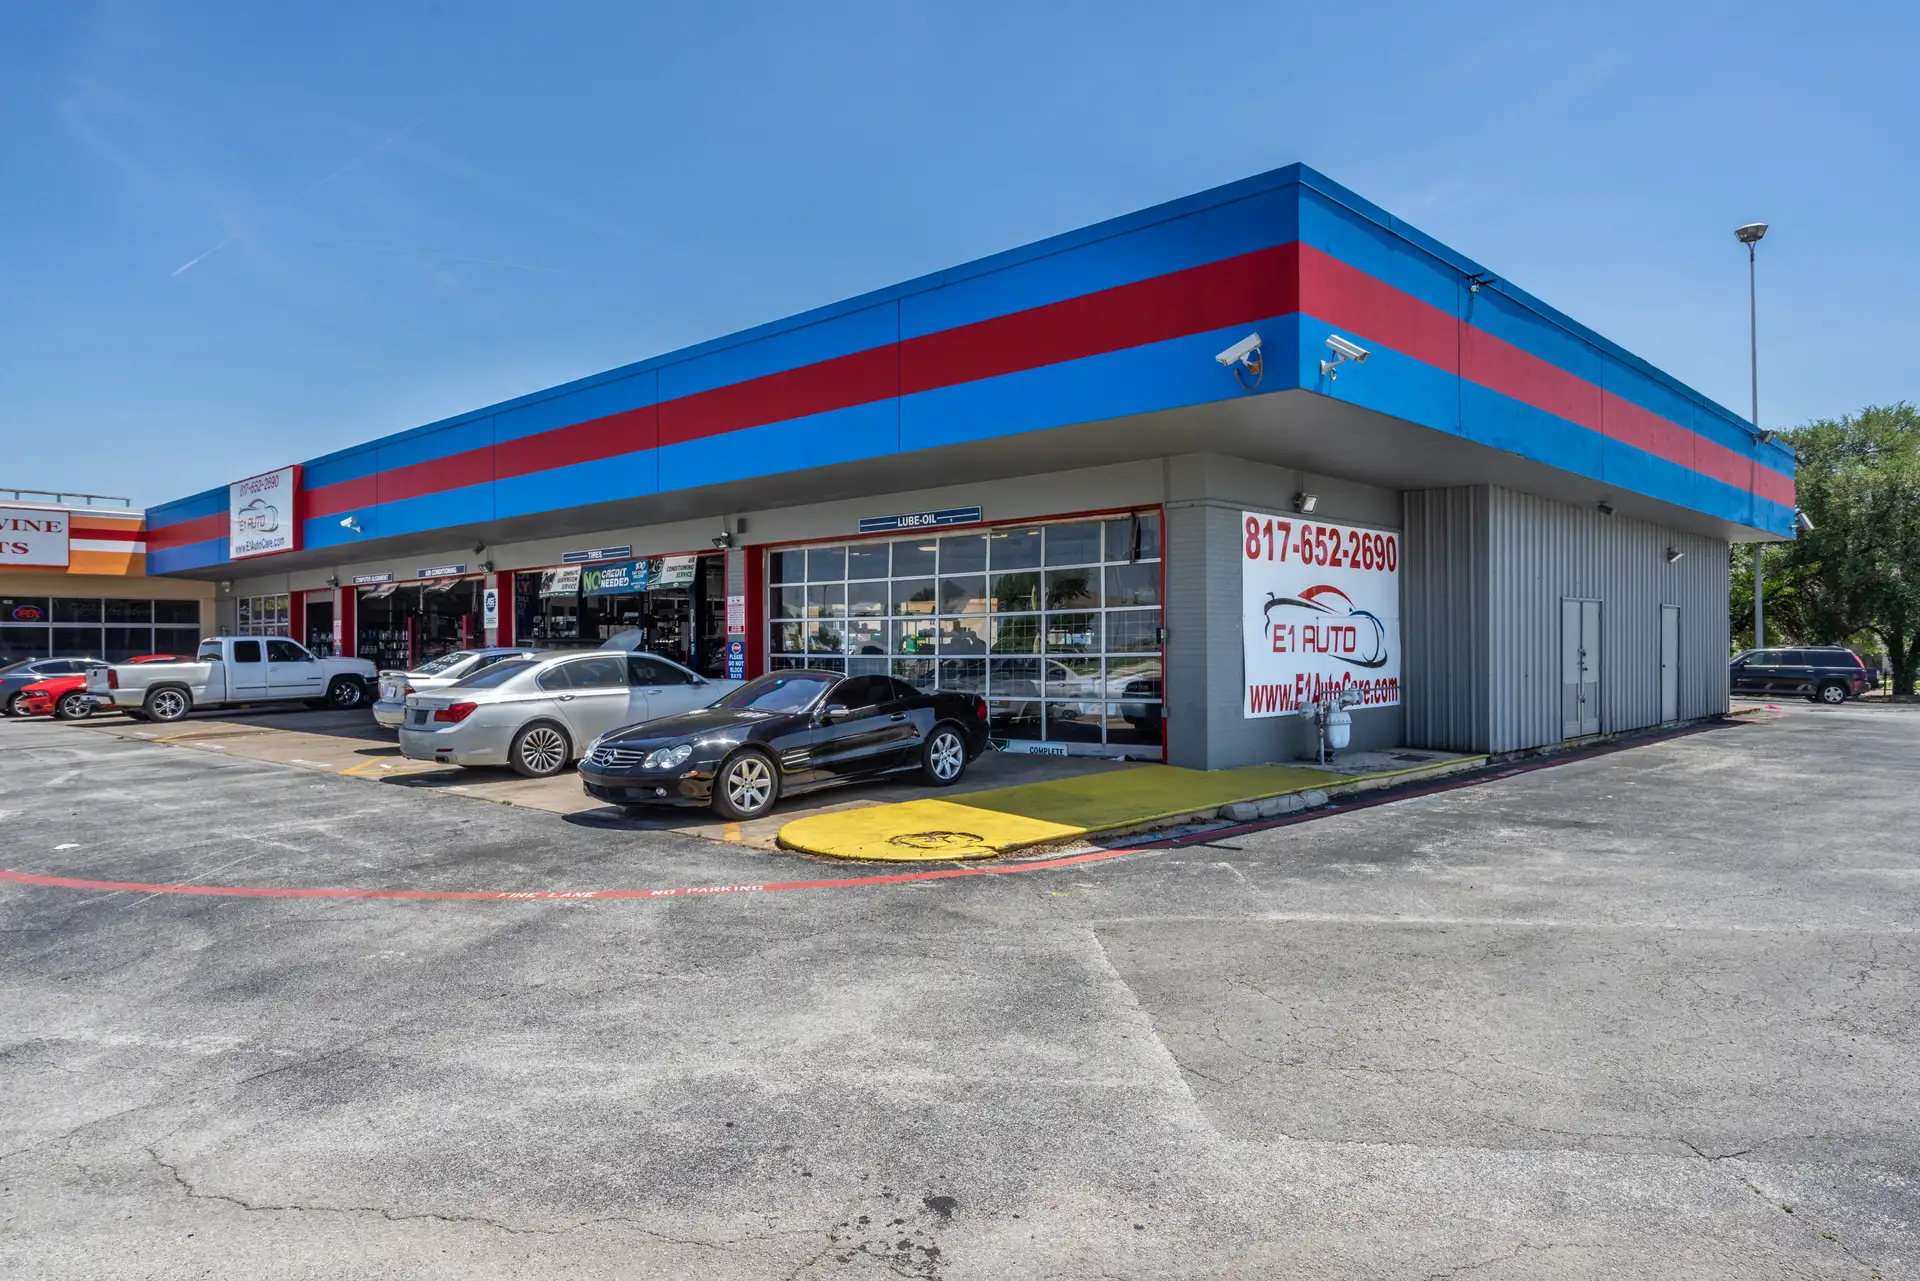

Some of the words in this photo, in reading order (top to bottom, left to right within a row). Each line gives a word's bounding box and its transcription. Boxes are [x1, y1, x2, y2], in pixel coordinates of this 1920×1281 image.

[897, 513, 937, 527] LUBE-OIL
[1245, 516, 1397, 572] 817-652-2690
[588, 551, 603, 559] TIRES
[601, 567, 627, 578] CREDIT
[666, 564, 694, 573] CONDITIONING
[583, 570, 600, 591] NO
[600, 577, 629, 588] NEEDED
[14, 609, 41, 618] OPEN
[1272, 624, 1295, 653] E1
[1302, 625, 1356, 653] AUTO
[1029, 746, 1065, 757] COMPLETE
[496, 891, 543, 899] FIRE
[651, 888, 676, 896] NO
[687, 884, 765, 894] PARKING
